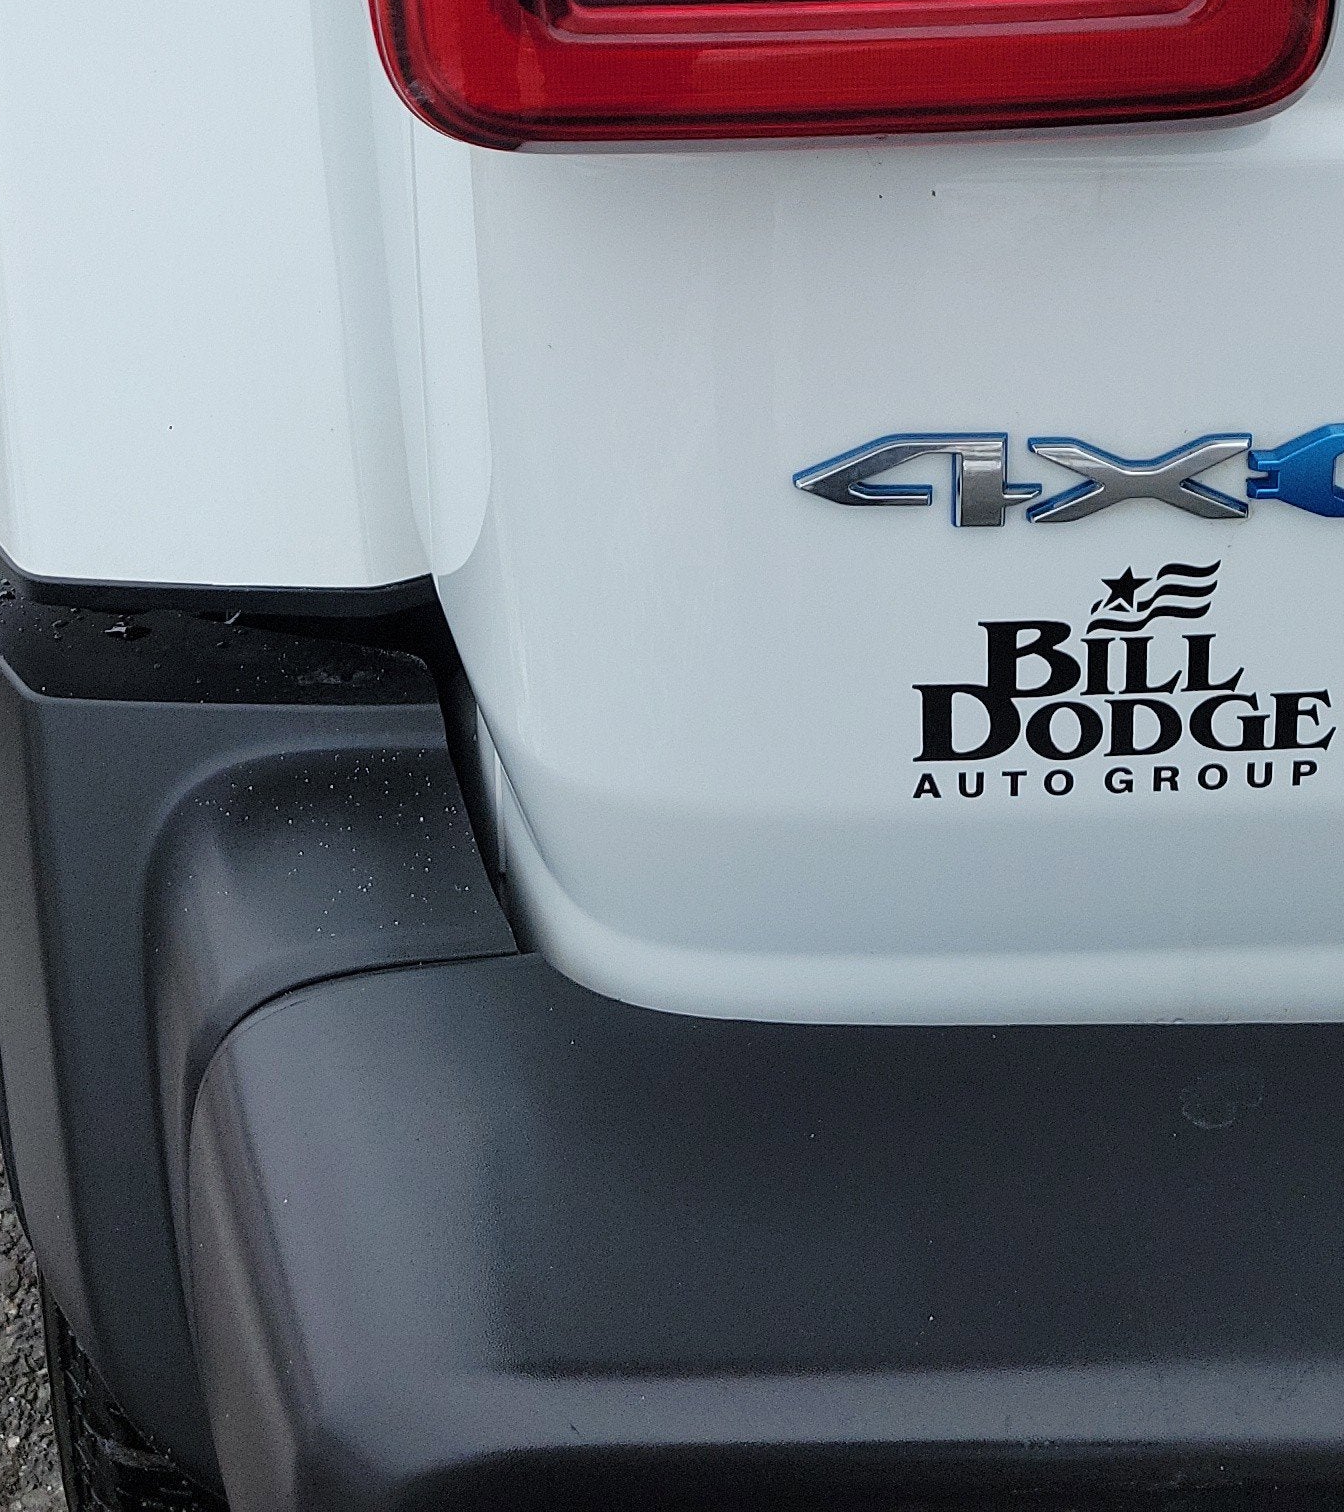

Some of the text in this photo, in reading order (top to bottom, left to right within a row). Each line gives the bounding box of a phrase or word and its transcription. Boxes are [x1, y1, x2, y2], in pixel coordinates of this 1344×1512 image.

[977, 619, 1245, 698] BILL
[911, 683, 1337, 763] DODGE
[912, 759, 1320, 799] AUTO GROUP
